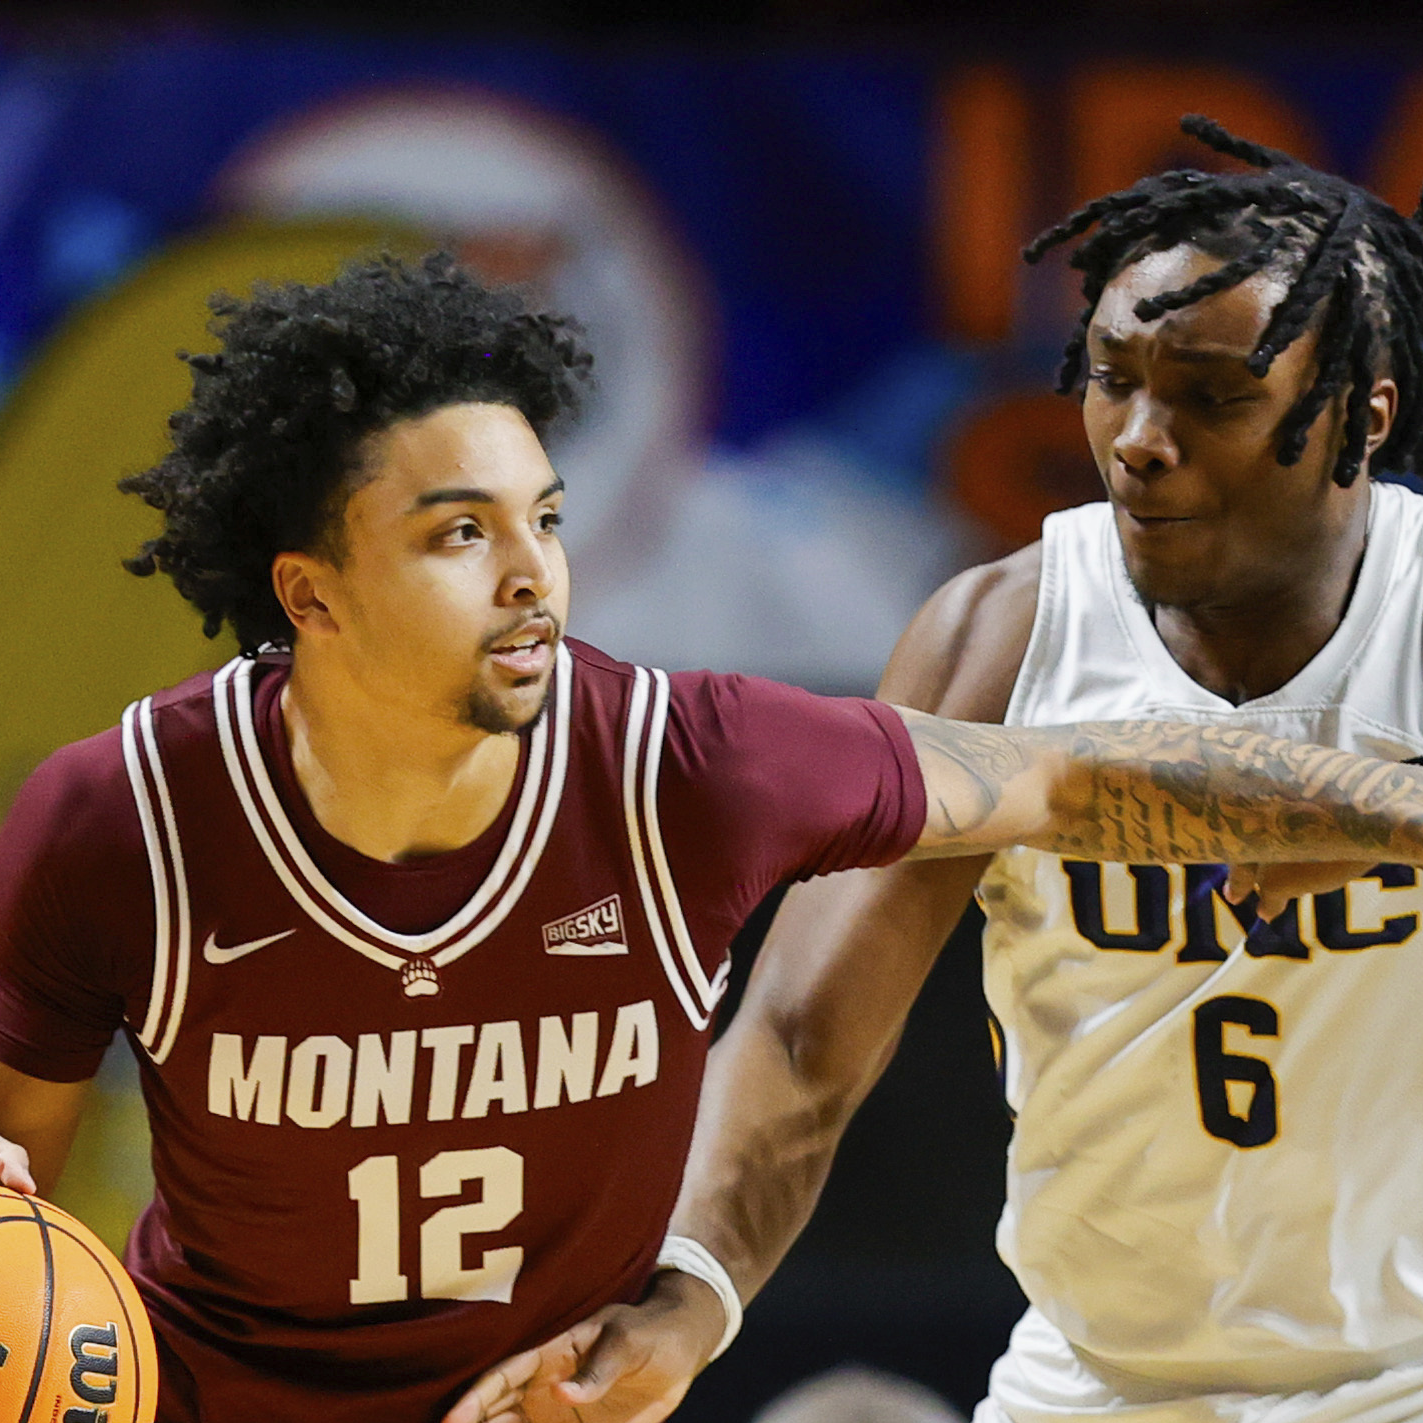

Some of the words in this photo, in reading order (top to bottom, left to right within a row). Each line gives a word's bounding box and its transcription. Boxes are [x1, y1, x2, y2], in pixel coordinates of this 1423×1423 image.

[1061, 860, 1421, 964] UNC
[207, 999, 660, 1129] MONTANA
[1192, 993, 1281, 1150] 6
[347, 1145, 525, 1305] 12
